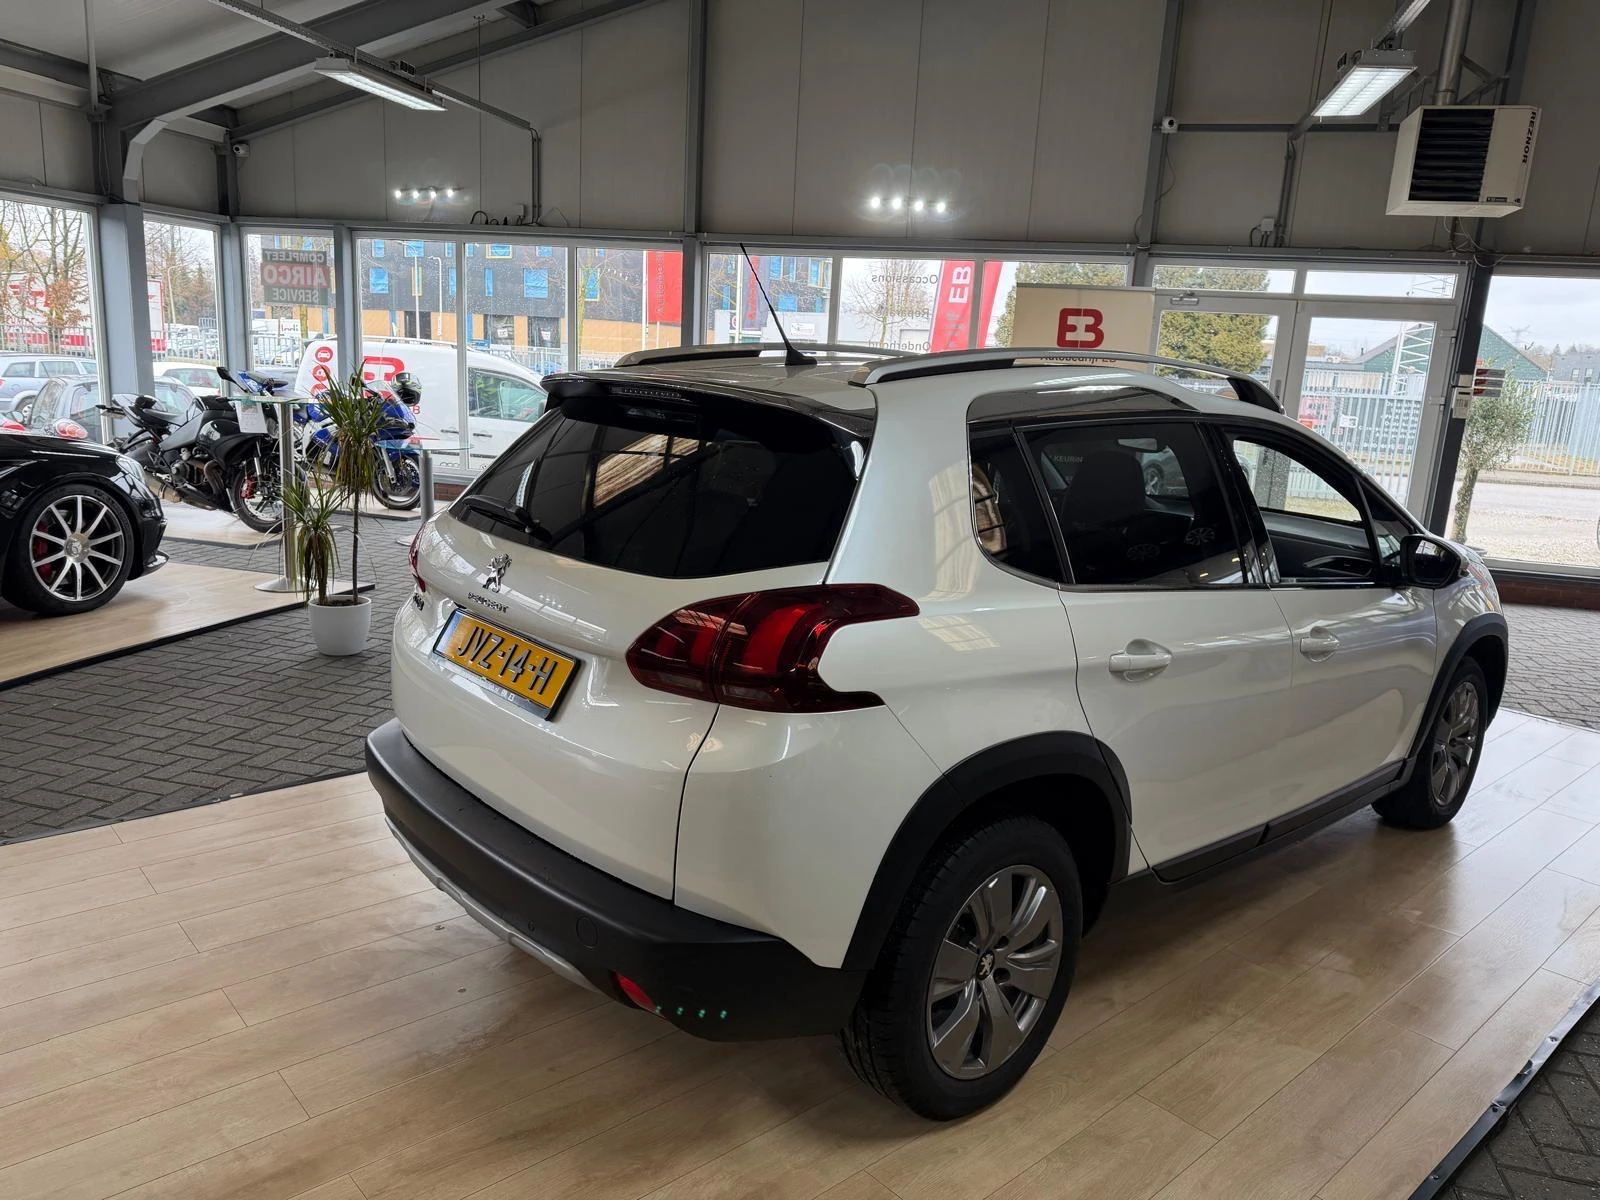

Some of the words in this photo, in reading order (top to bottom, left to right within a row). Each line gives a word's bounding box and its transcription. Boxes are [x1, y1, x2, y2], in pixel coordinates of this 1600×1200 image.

[1521, 111, 1537, 163] REZNOR
[948, 265, 972, 304] EB
[1057, 307, 1105, 349] EB
